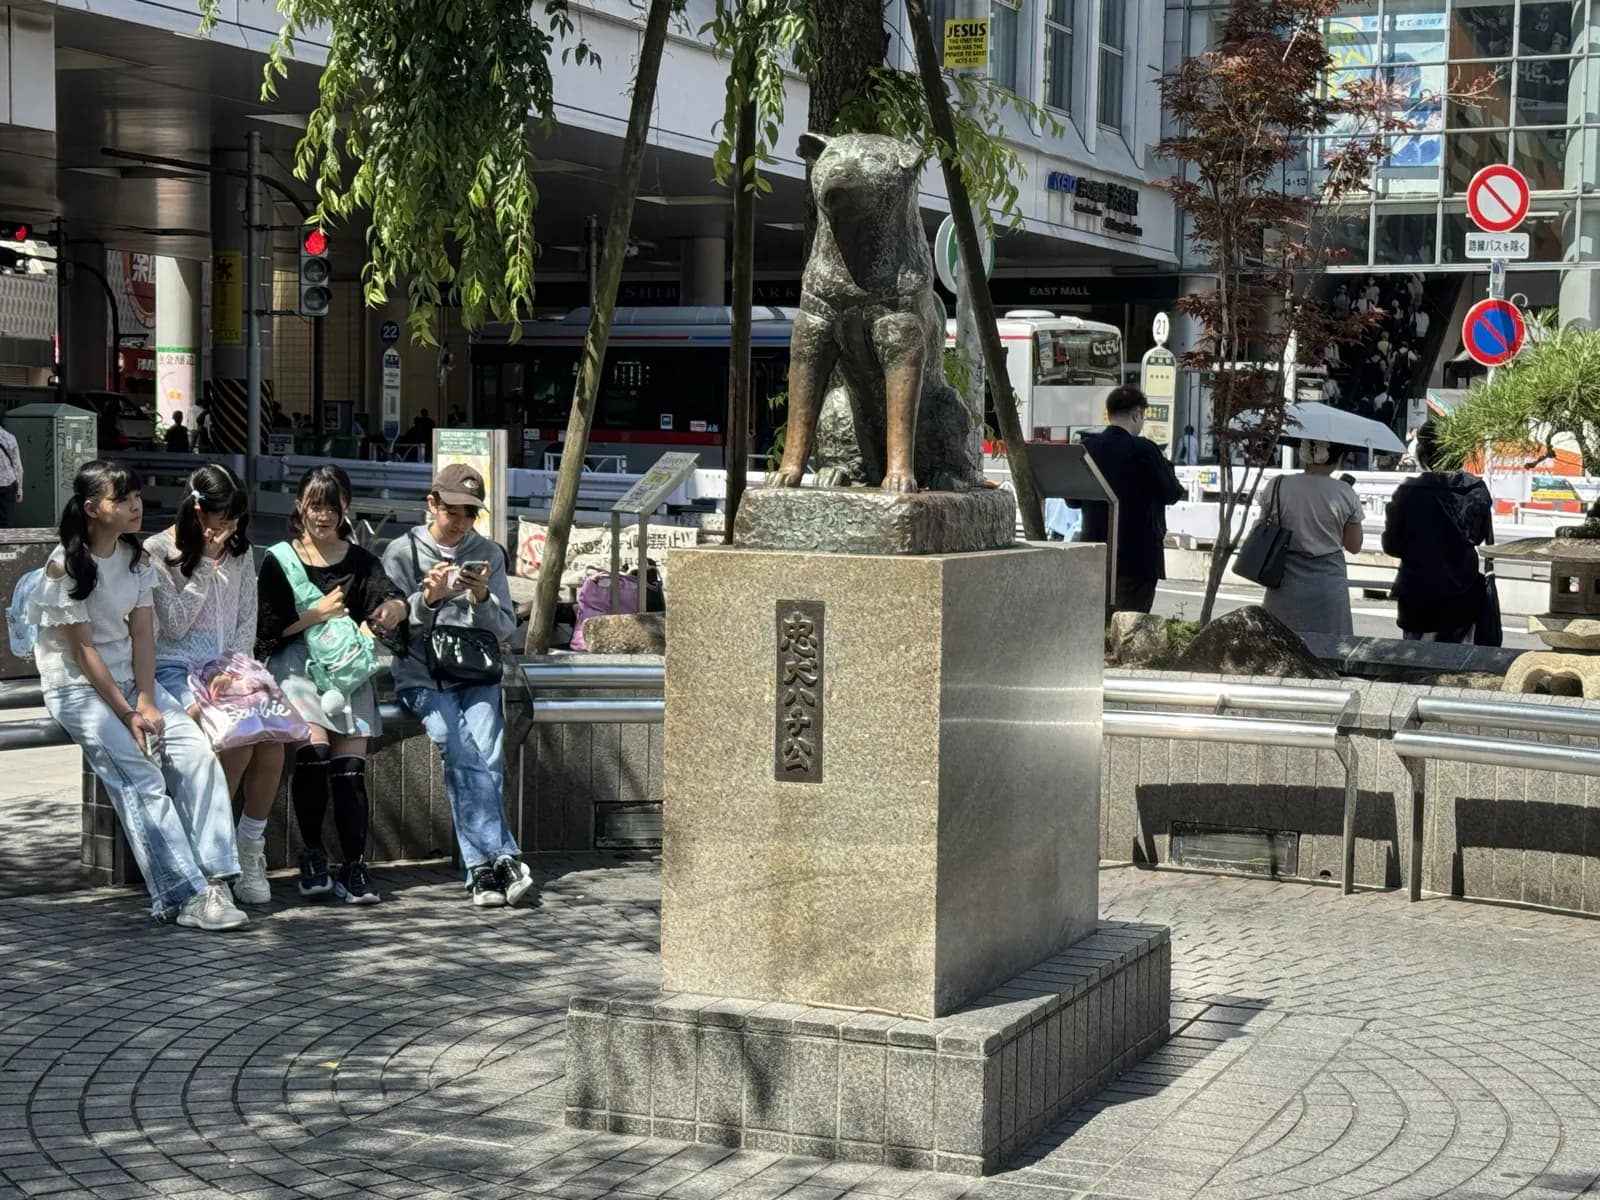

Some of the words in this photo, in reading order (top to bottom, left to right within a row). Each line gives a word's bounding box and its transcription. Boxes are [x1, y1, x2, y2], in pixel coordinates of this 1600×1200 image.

[946, 23, 986, 38] JESUS
[1469, 239, 1526, 252] 路線バスを除く
[1030, 287, 1058, 296] EAST
[1060, 287, 1091, 296] MALL
[383, 325, 398, 338] 22
[1155, 319, 1167, 335] 21
[780, 610, 818, 774] 忠犬ハチ公
[222, 696, 292, 726] Barbie
